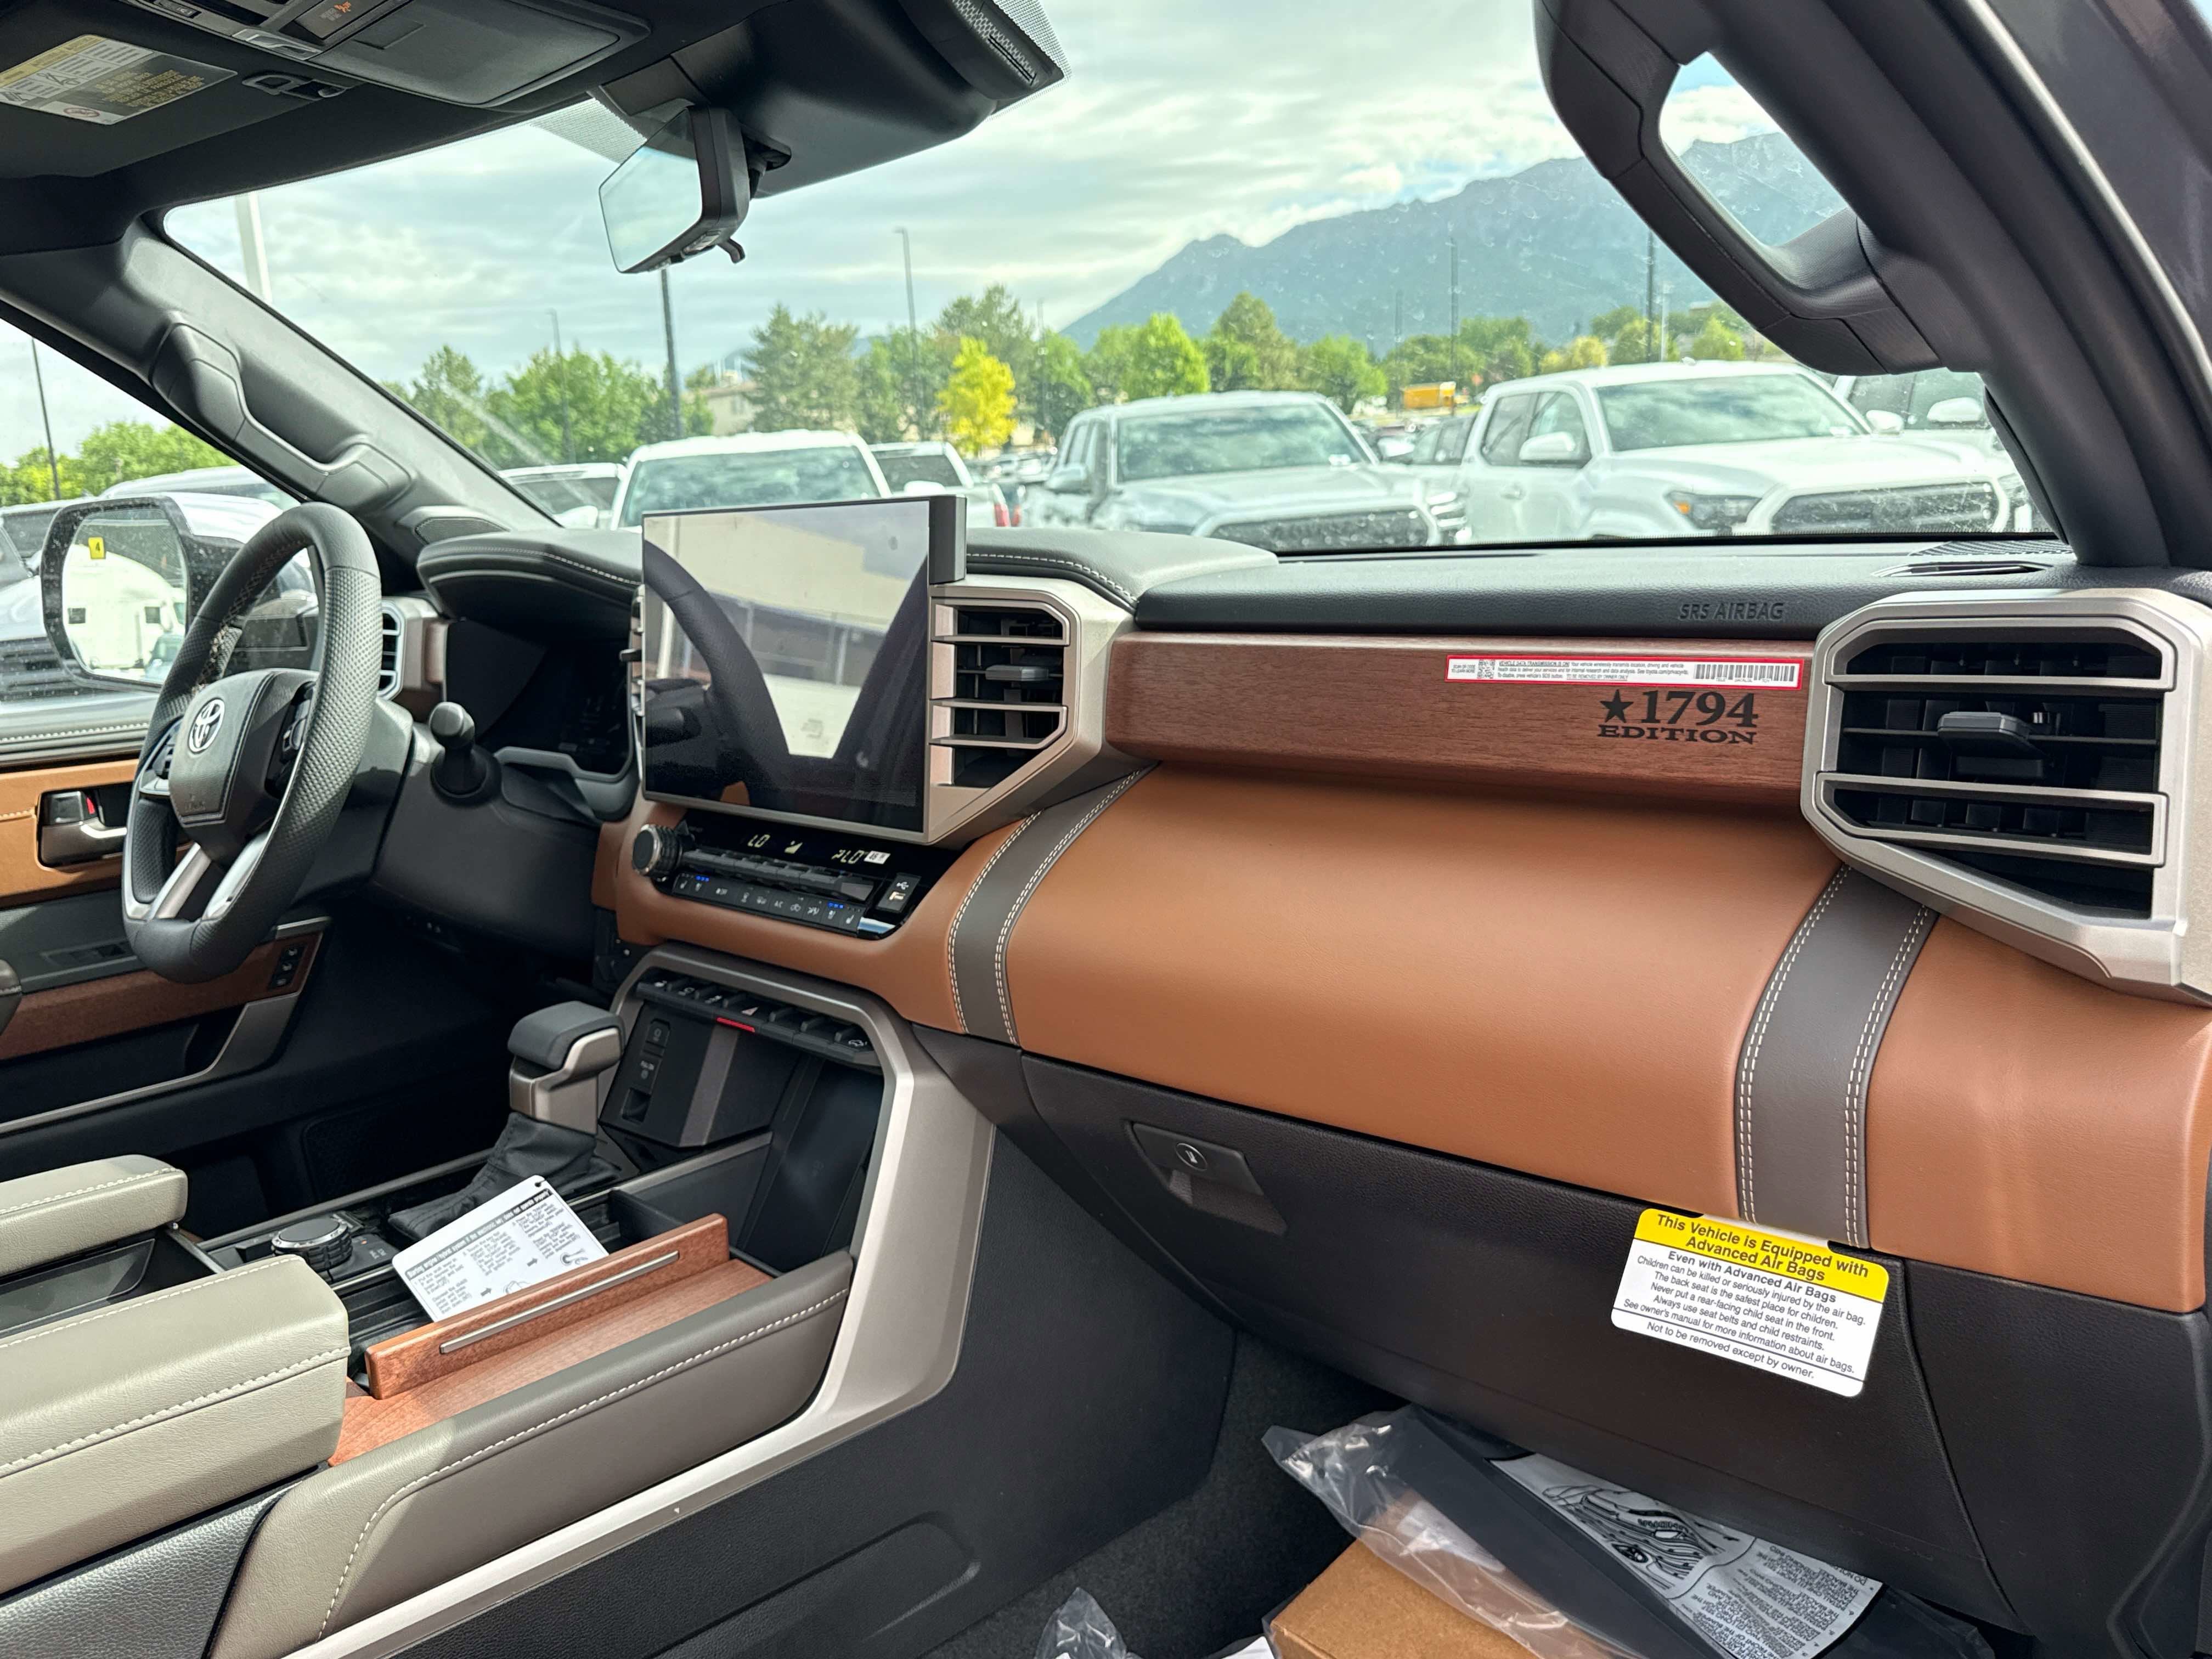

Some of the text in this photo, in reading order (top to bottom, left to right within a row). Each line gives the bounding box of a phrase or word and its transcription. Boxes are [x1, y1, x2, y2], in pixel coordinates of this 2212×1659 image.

[1679, 603, 1784, 621] SRS AIRBAG
[1598, 724, 1757, 744] EDITION
[1640, 690, 1758, 727] 1794
[1658, 1214, 1867, 1277] This Vehicle is Equipped with
[1685, 1236, 1825, 1280] Advanced Air Bags
[1638, 1255, 1668, 1269] Children
[1670, 1265, 1684, 1273] can
[1686, 1268, 1697, 1277] be
[1699, 1271, 1720, 1283] killed
[1733, 1282, 1770, 1298] seriously
[1771, 1290, 1801, 1305] injured
[1803, 1299, 1813, 1310] by
[1816, 1303, 1830, 1313] the
[1832, 1308, 1844, 1317] air
[1846, 1311, 1865, 1325] bag.
[1655, 1271, 1837, 1329] The back seat is the safest place for children.
[1668, 1251, 1836, 1302] Even with Advanced Air Bags
[1624, 1299, 1853, 1373] See owner's manual for more information about air bags.
[1651, 1282, 1674, 1294] Never
[1674, 1290, 1688, 1299] put
[1697, 1296, 1741, 1314] rear-facing
[1743, 1308, 1763, 1319] child
[1764, 1314, 1784, 1325] seat
[1785, 1318, 1793, 1328] in
[1796, 1322, 1809, 1333] the
[1812, 1326, 1834, 1340] front.
[1653, 1295, 1824, 1350] Always use seat belts and child restraints.
[1647, 1322, 1813, 1378] Not to be removed except by owner.
